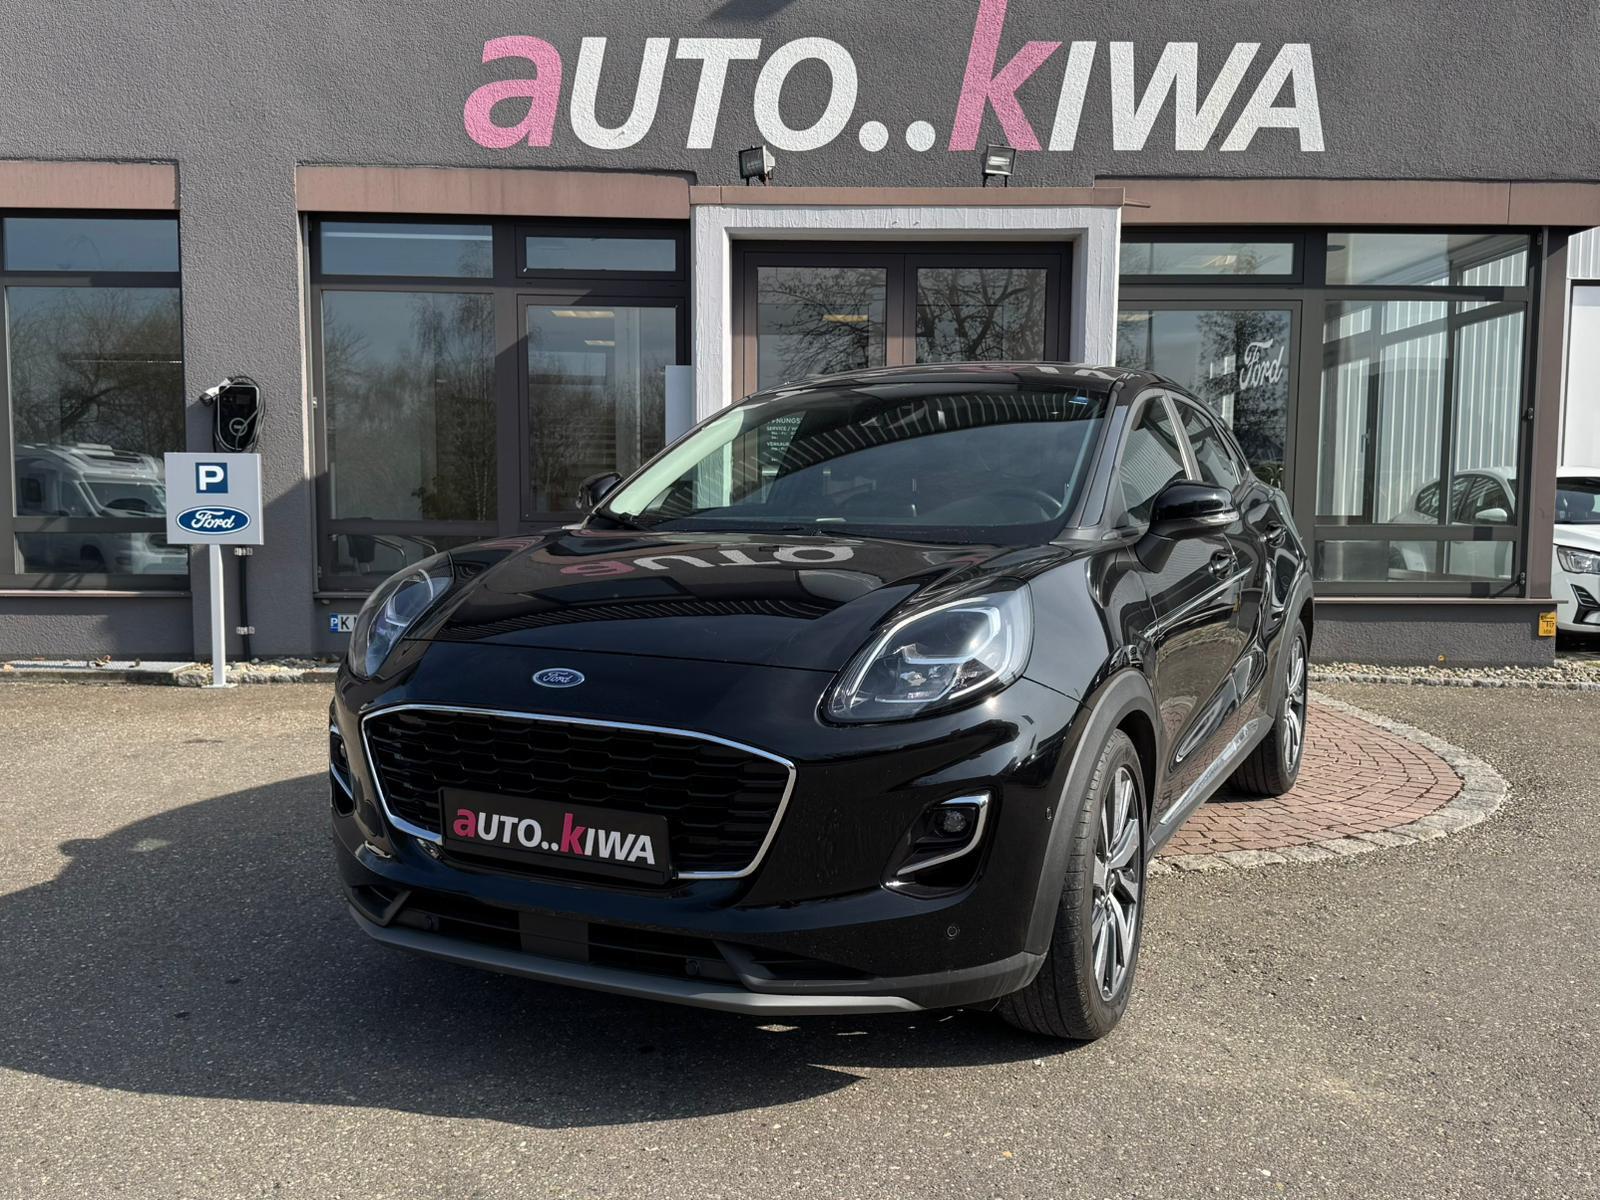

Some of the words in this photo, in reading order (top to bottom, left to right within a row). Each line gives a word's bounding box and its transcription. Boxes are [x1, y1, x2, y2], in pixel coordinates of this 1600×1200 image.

[1239, 338, 1285, 390] Ford
[198, 465, 225, 491] P
[191, 510, 235, 529] Ford
[542, 671, 574, 684] Ford
